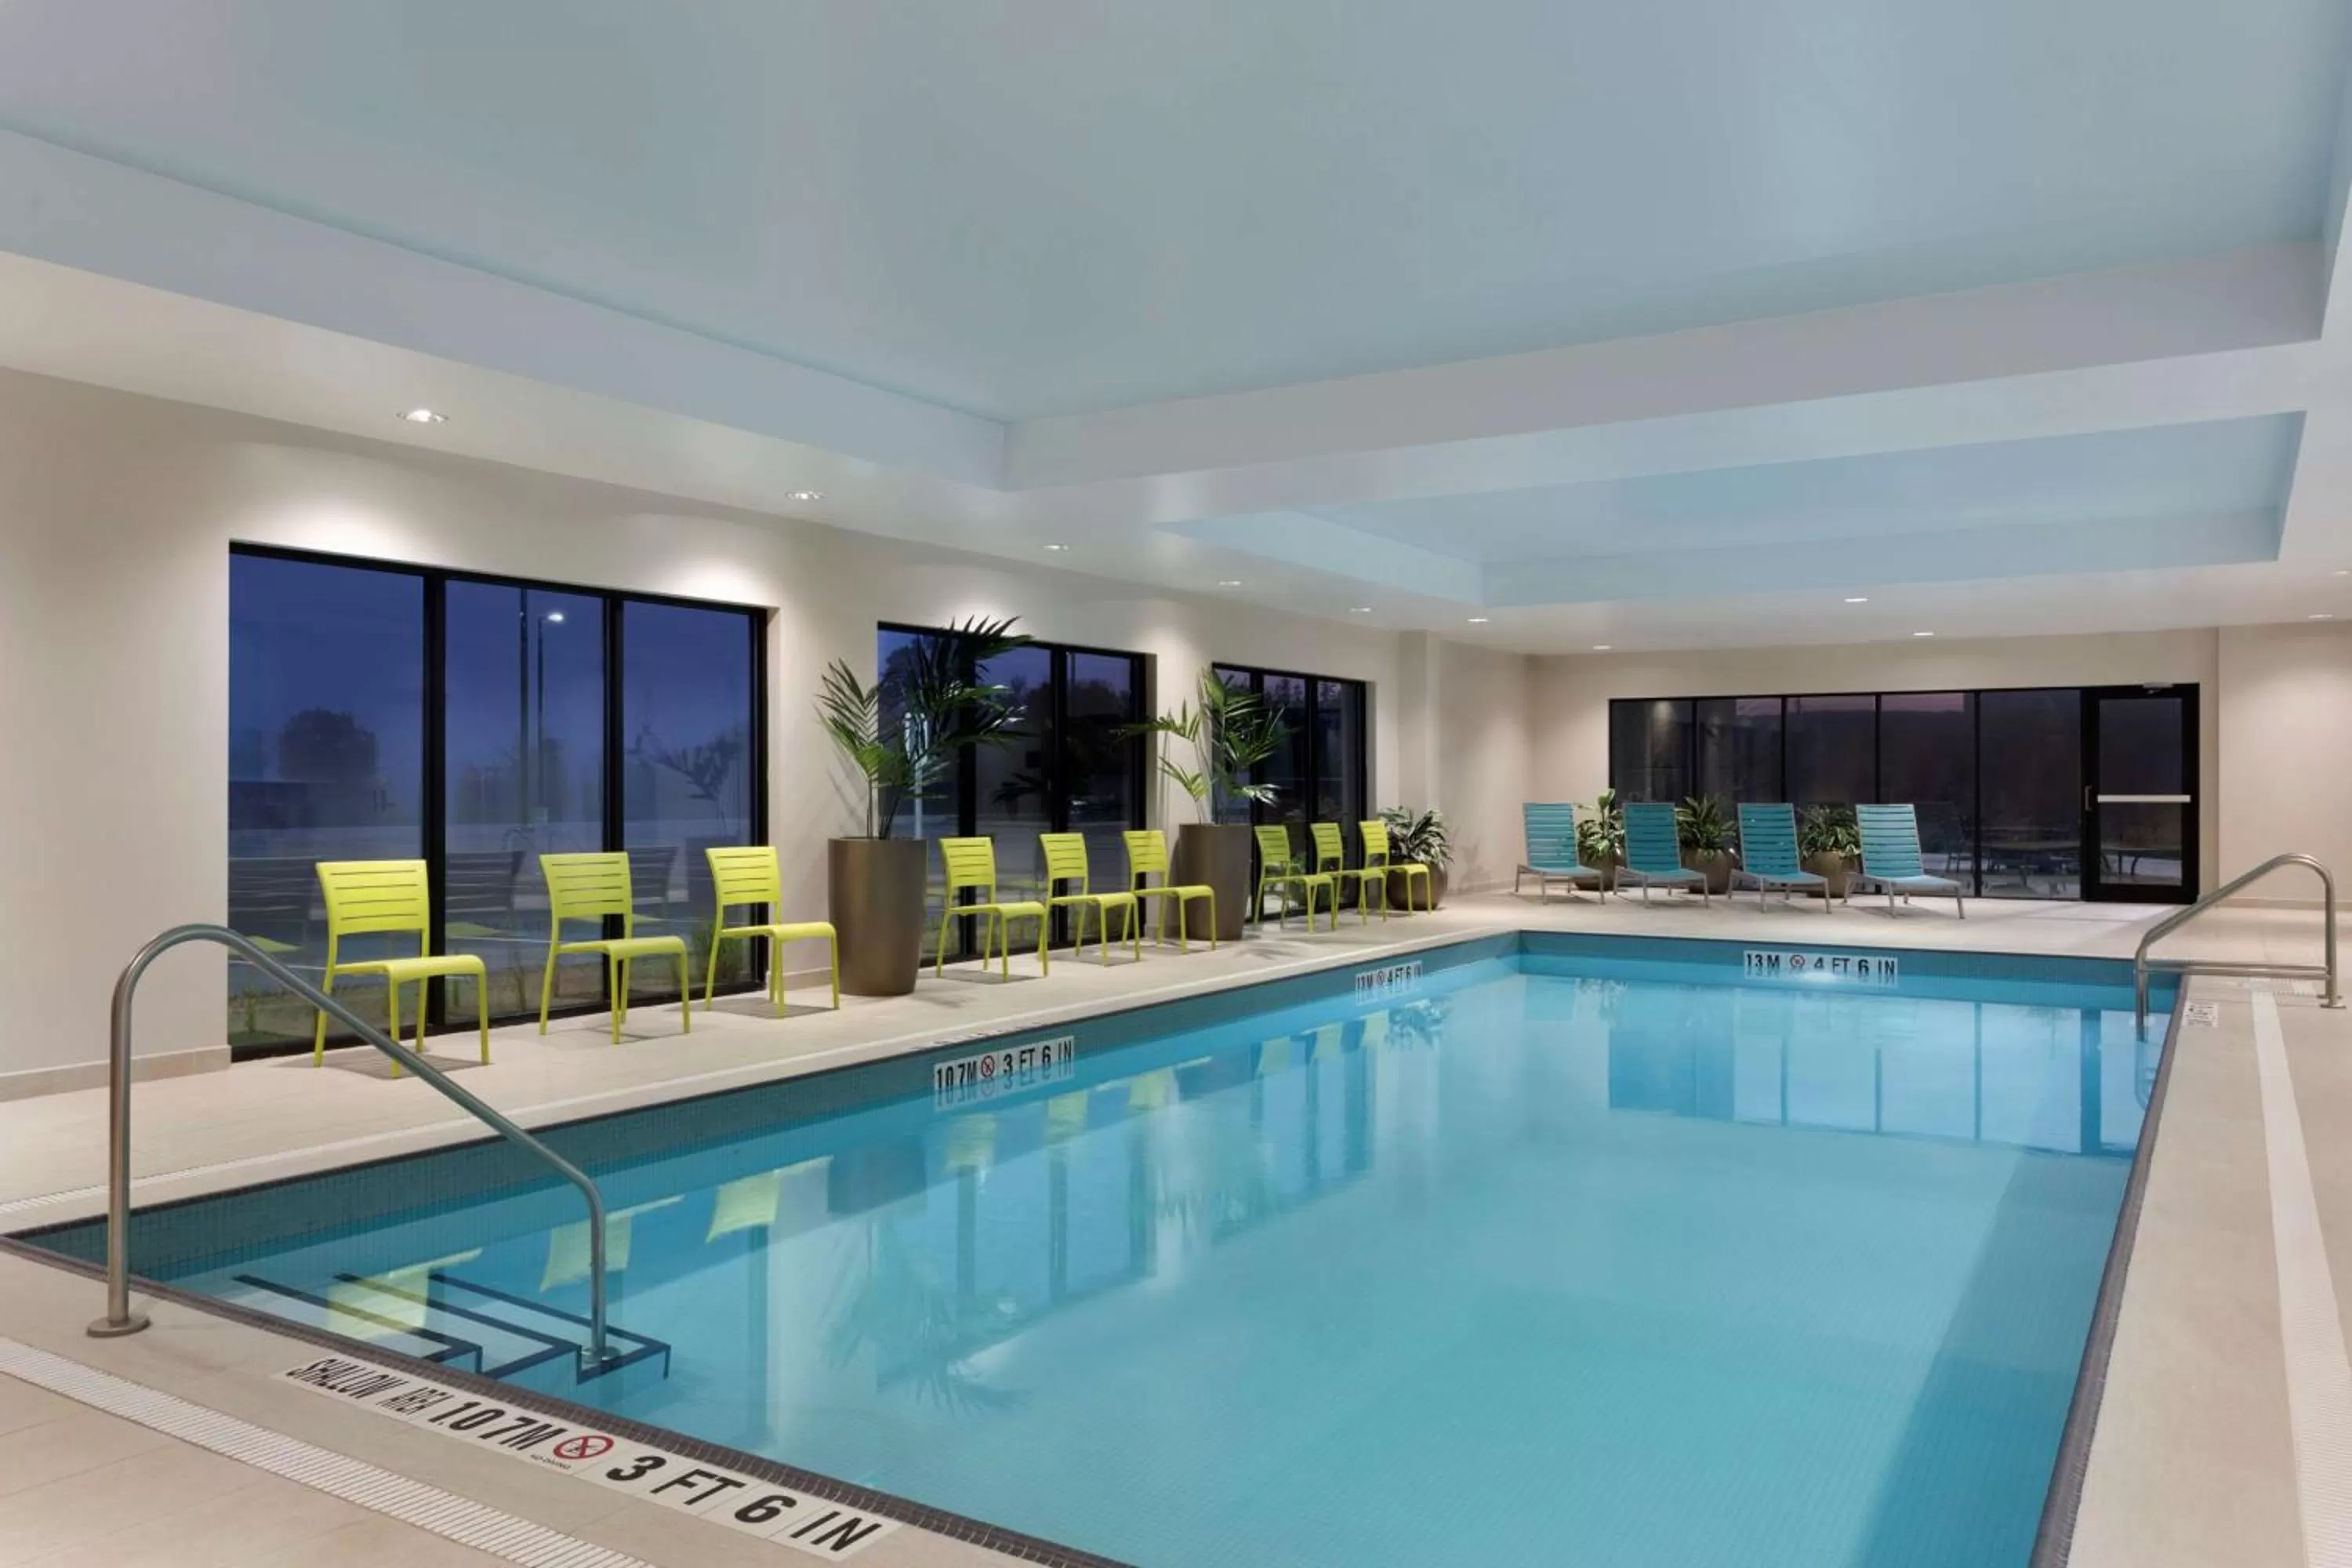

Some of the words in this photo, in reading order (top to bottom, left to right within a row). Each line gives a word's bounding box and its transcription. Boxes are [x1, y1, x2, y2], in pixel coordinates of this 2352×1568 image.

[1813, 956, 1824, 970] 4
[1832, 958, 1851, 975] FT
[1857, 959, 1869, 976] 6
[1878, 960, 1895, 976] IN
[1003, 1054, 1013, 1075] 3
[1019, 1048, 1036, 1069] FT
[1042, 1045, 1051, 1065] 6
[1058, 1040, 1072, 1061] IN
[286, 1359, 409, 1399] SHALLOW
[376, 1386, 456, 1416] AREA
[606, 1456, 666, 1481] 3
[650, 1468, 746, 1506] FT
[735, 1494, 797, 1523] 6
[790, 1511, 883, 1552] IN
